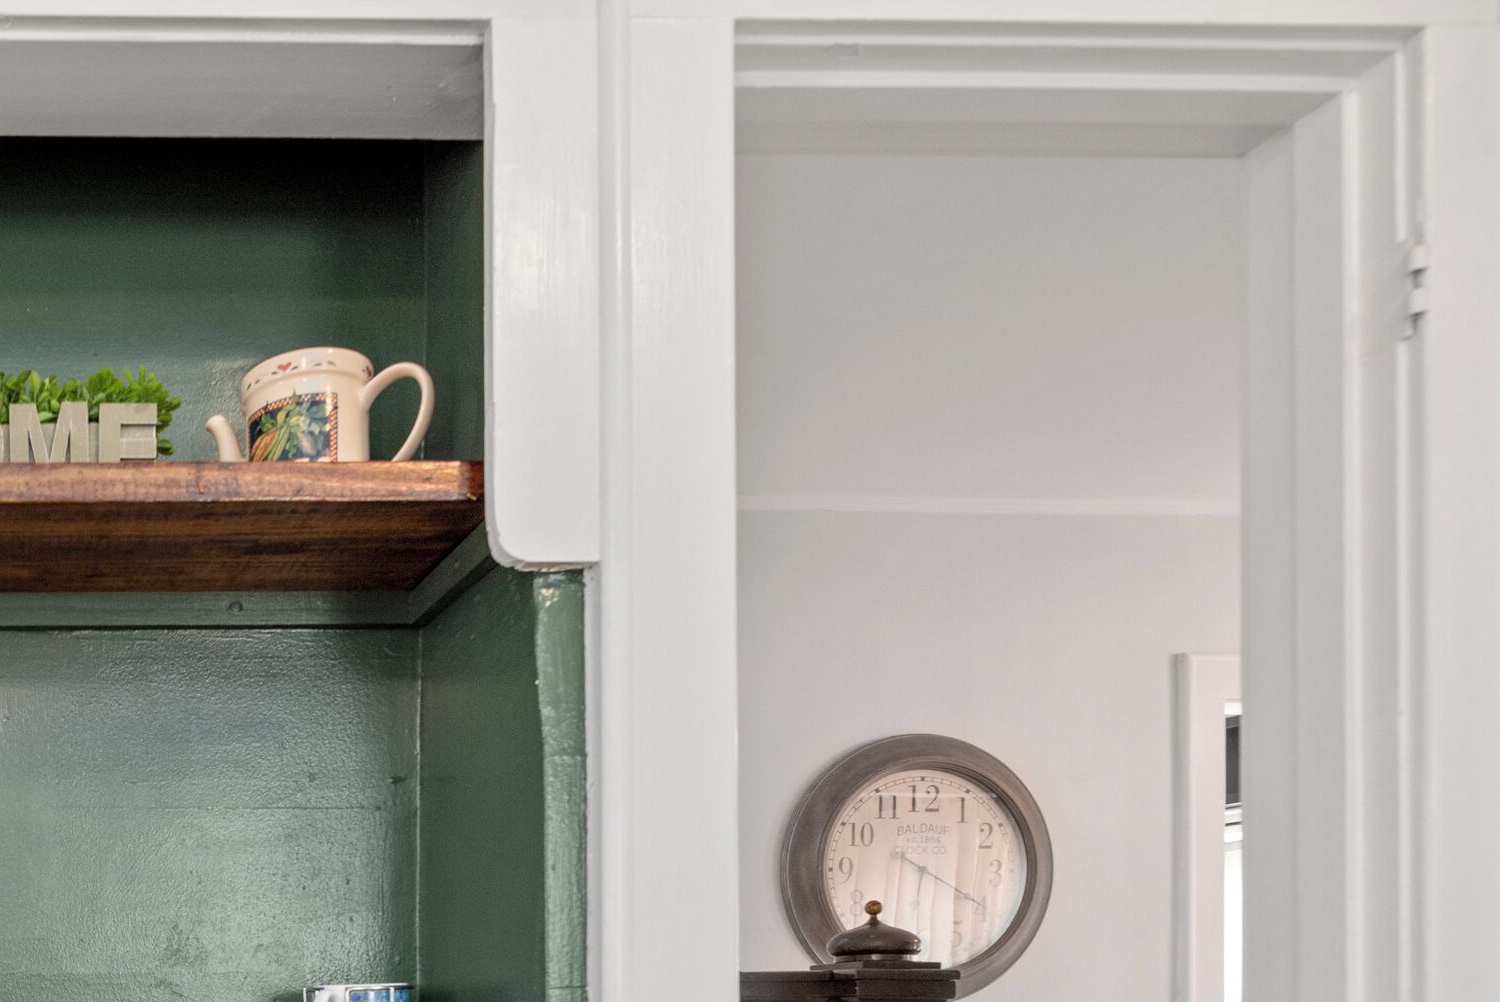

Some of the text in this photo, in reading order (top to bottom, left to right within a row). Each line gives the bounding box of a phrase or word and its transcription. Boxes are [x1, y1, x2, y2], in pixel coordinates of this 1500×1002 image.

[875, 794, 900, 820] 11
[907, 784, 940, 813] 12
[956, 796, 969, 823] 1
[848, 822, 874, 848] 10
[896, 823, 950, 837] BALDAUF
[978, 822, 993, 849] 2
[838, 856, 853, 884] 9
[989, 859, 1003, 887] 3
[849, 889, 864, 917] 8
